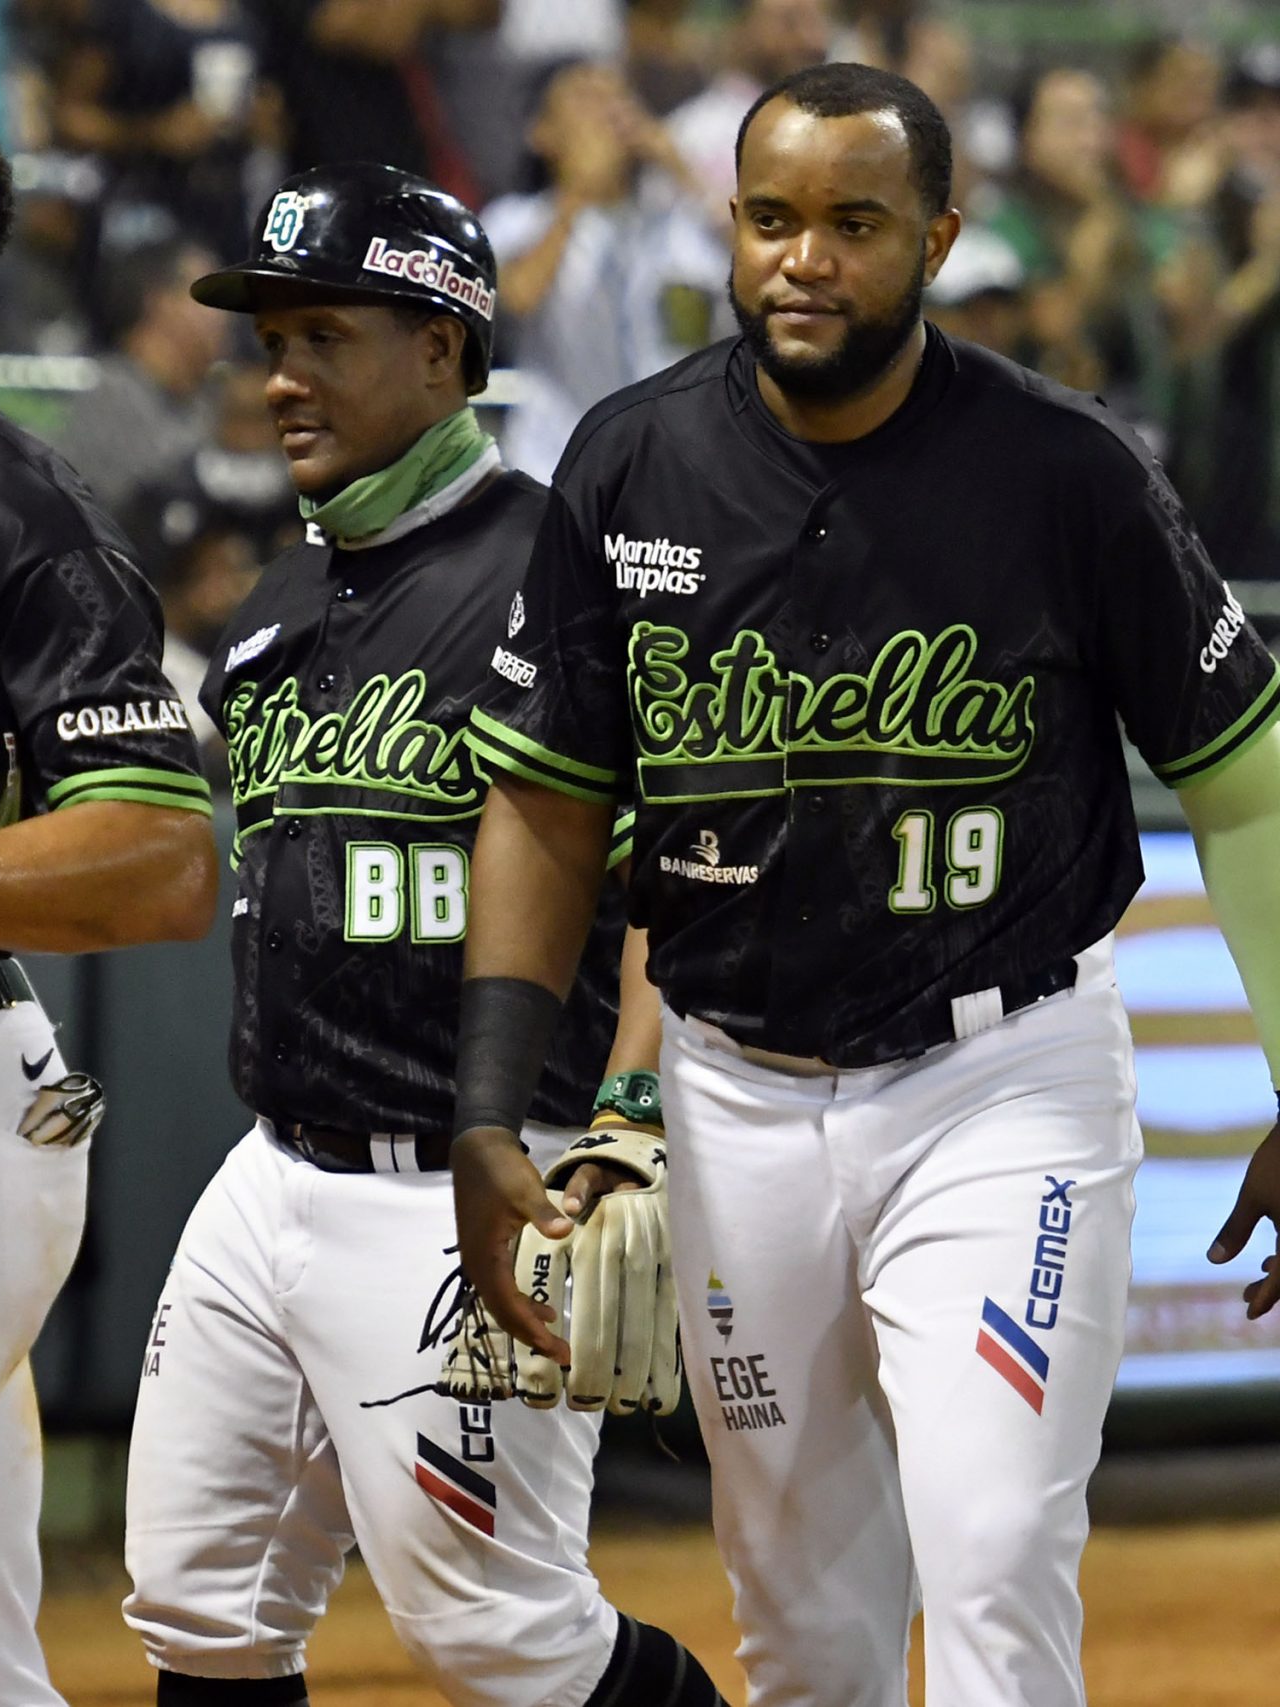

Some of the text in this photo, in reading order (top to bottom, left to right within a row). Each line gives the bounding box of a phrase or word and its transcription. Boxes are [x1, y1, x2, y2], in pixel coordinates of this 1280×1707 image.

[604, 533, 702, 569] Manitas
[616, 561, 699, 598] Limpias
[628, 620, 1036, 762] Estrellas
[659, 855, 760, 886] BANRESERVAS
[887, 804, 1005, 914] 19
[344, 841, 470, 944] BB
[709, 1353, 777, 1401] EGE
[721, 1401, 787, 1431] HAINA
